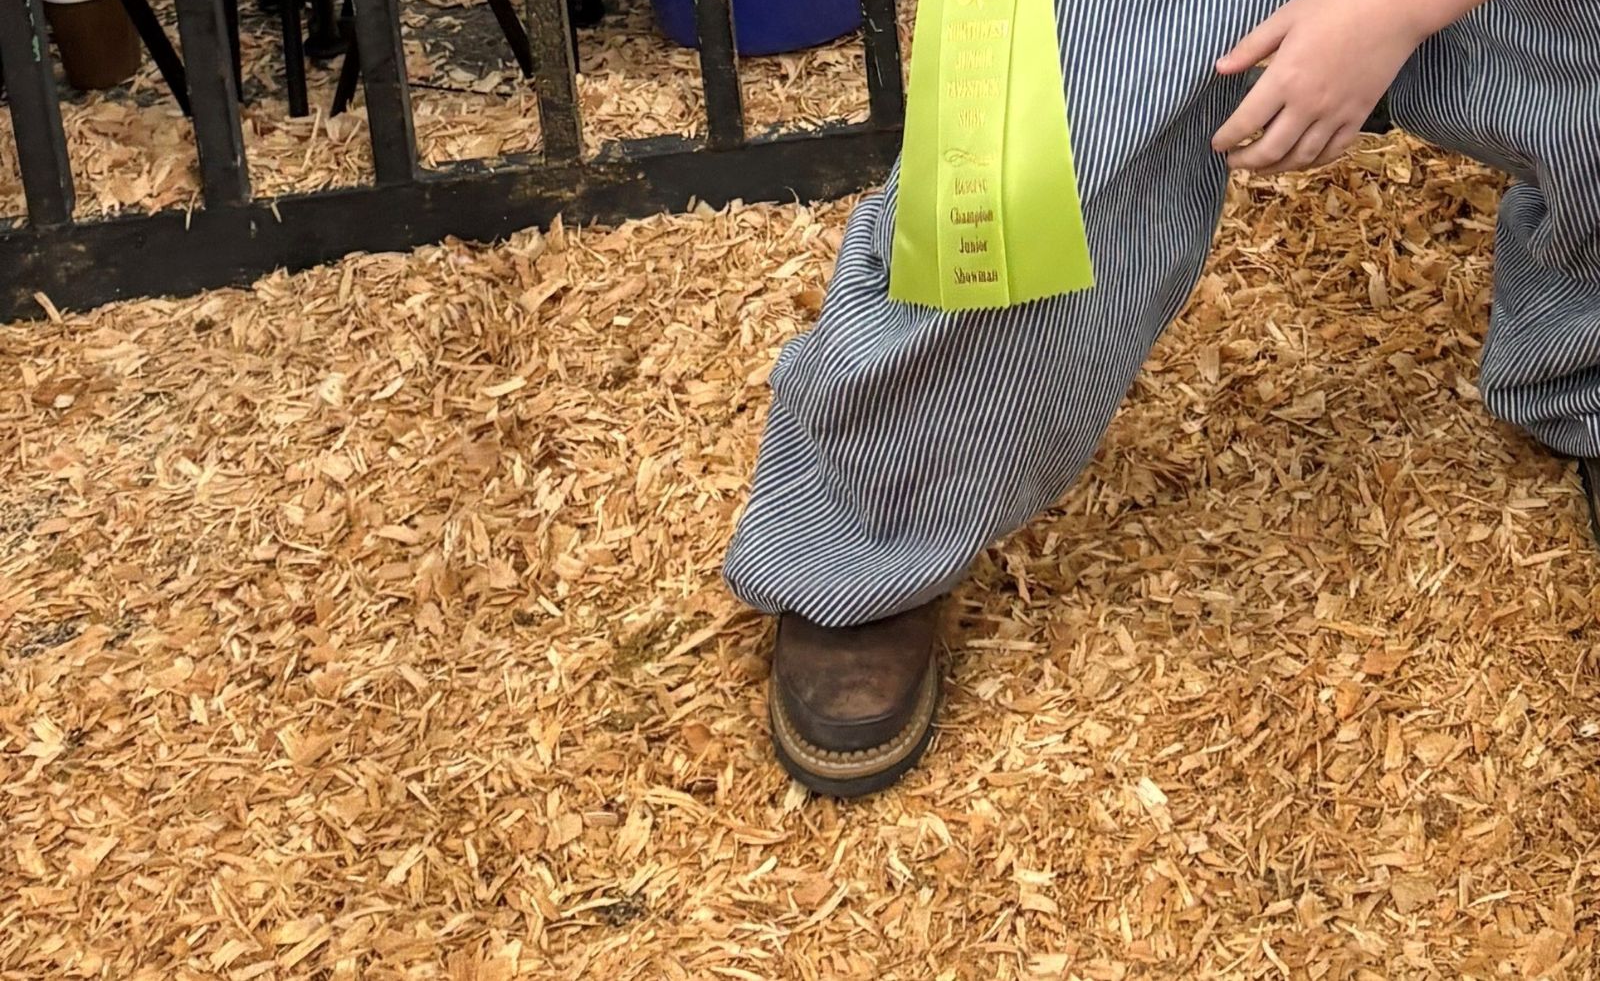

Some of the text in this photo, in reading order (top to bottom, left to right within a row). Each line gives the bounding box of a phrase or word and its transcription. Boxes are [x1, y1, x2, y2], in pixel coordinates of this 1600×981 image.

[950, 206, 994, 228] Champion
[959, 236, 988, 254] Junior
[954, 267, 998, 284] Showman
